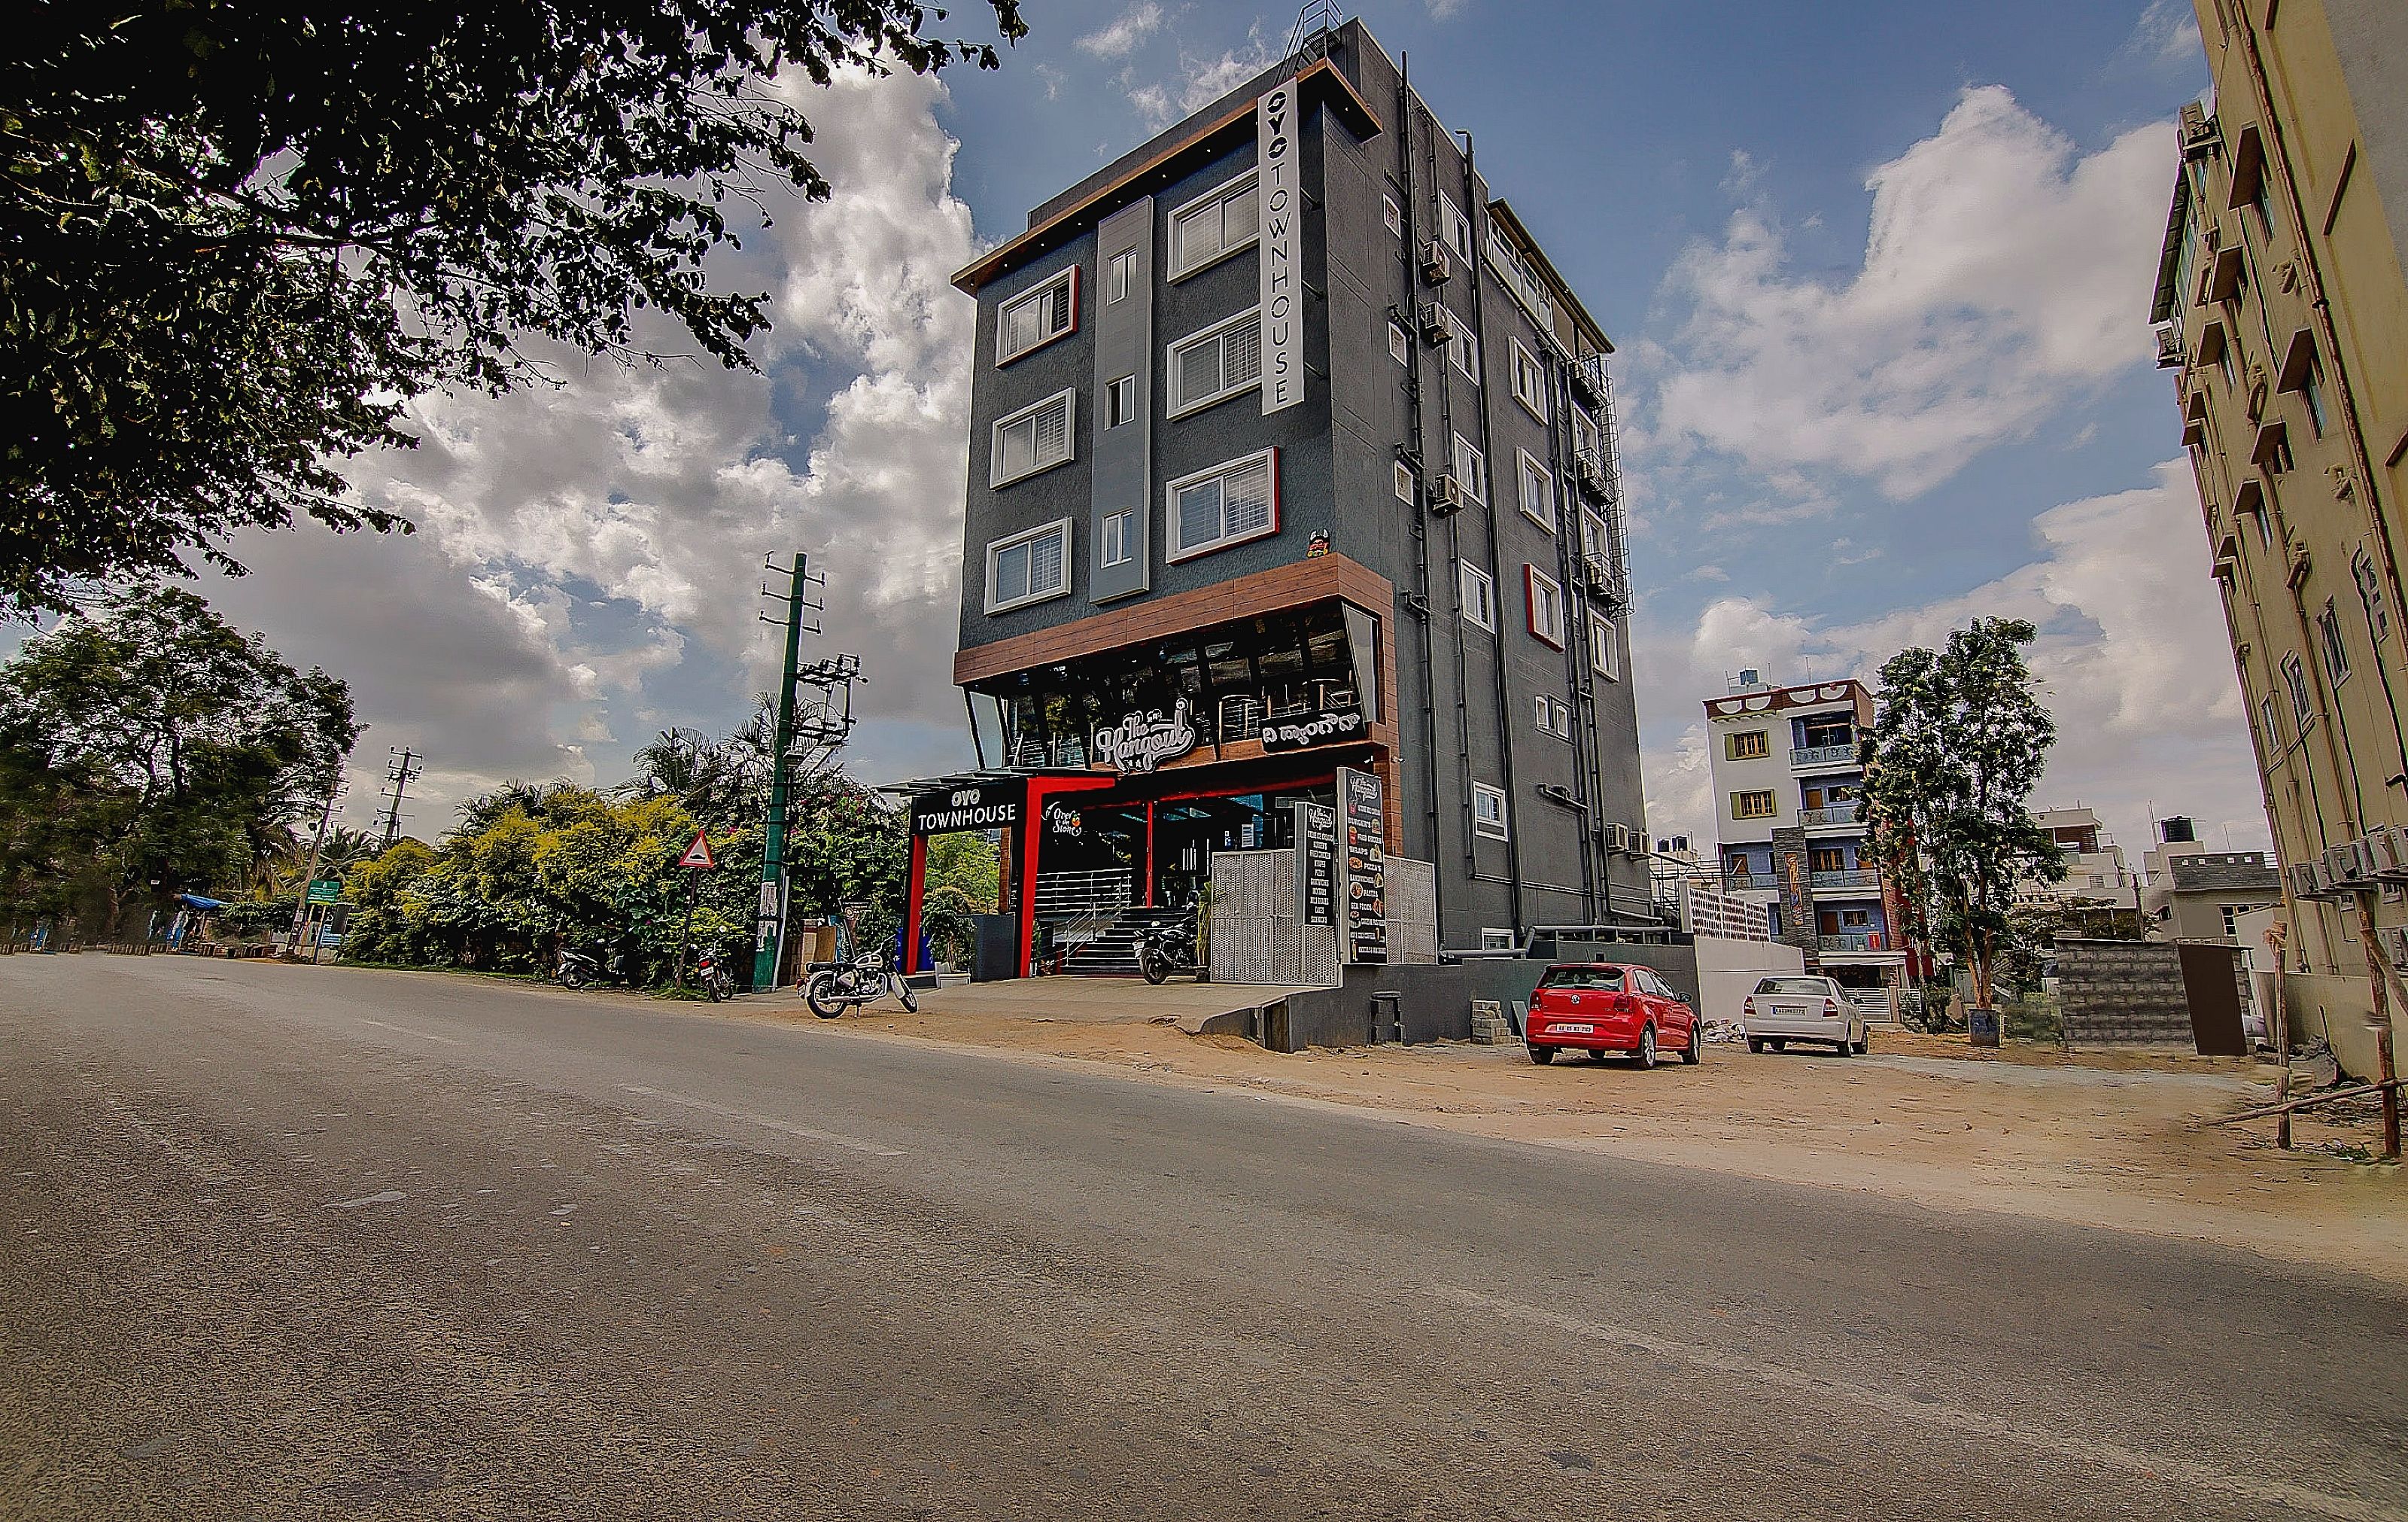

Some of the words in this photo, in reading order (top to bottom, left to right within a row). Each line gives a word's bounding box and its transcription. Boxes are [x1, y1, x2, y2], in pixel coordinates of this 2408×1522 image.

[1267, 91, 1288, 159] OYO
[1269, 162, 1291, 405] TOWNHOUSE
[1096, 700, 1193, 771] Hangout
[1123, 714, 1149, 741] The
[952, 789, 981, 807] OYO
[918, 803, 1016, 830] TOWNHOUSE
[1348, 845, 1369, 856] WRAPS
[1364, 862, 1382, 872] PIZZA'S
